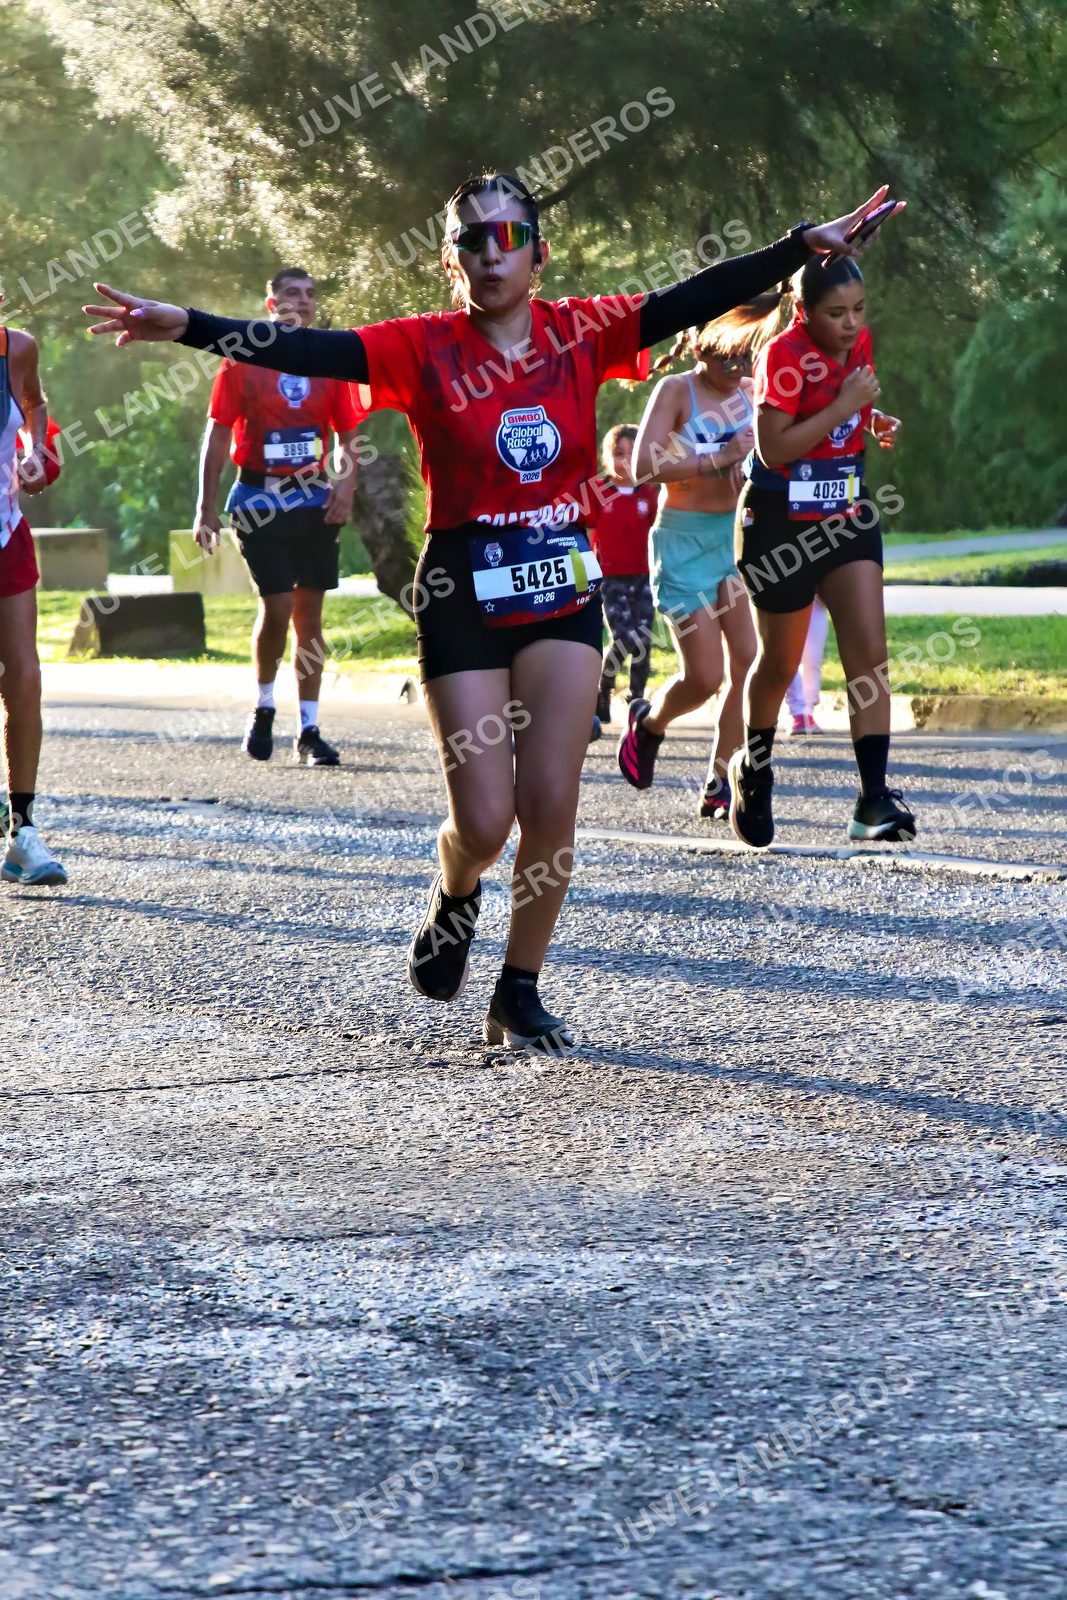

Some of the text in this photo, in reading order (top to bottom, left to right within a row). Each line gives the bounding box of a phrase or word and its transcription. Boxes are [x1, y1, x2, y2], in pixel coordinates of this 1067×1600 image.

[507, 413, 541, 424] BIMBO
[512, 425, 543, 438] Global
[507, 437, 532, 448] Race
[522, 471, 540, 482] 2026
[813, 481, 845, 499] 4029
[510, 557, 568, 593] 5425
[533, 591, 556, 605] 20-26
